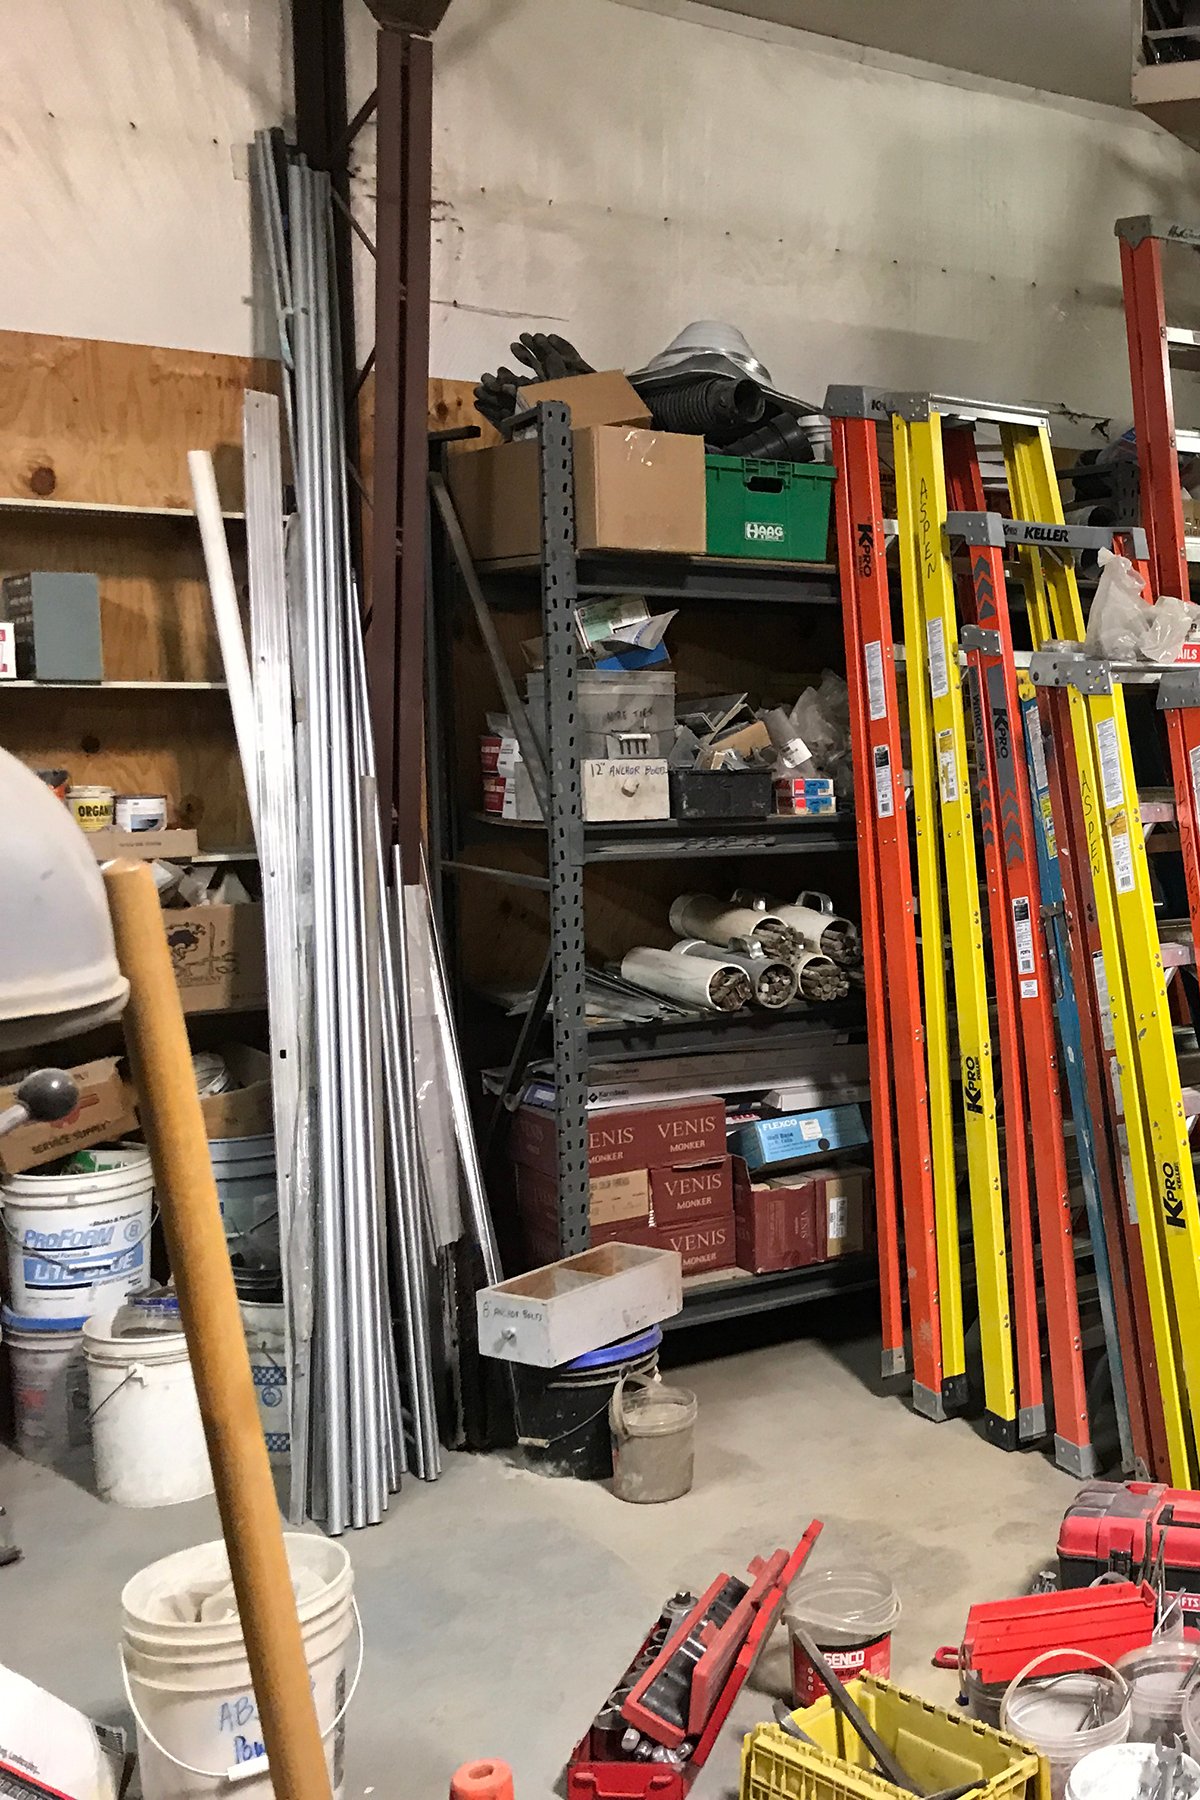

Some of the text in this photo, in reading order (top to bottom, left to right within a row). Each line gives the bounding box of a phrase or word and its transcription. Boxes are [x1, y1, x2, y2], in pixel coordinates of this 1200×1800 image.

[745, 523, 784, 538] HAAG
[919, 476, 937, 579] ASPEN
[1024, 526, 1069, 543] KELLER
[992, 707, 1009, 759] KPRO
[609, 765, 640, 777] ANCHOR
[1081, 769, 1101, 877] ASPEN
[964, 1055, 984, 1115] KPRO
[658, 1116, 717, 1139] VENIS
[762, 1118, 798, 1132] FLEXCO
[589, 1127, 634, 1149] ENIS
[669, 1140, 706, 1153] MONKER
[664, 1173, 722, 1197] VENIS
[1162, 1161, 1187, 1230] KPRO
[676, 1197, 712, 1210] MONKER
[670, 1228, 727, 1252] VENIS
[682, 1253, 717, 1266] MONKER
[823, 1650, 865, 1667] SENCO
